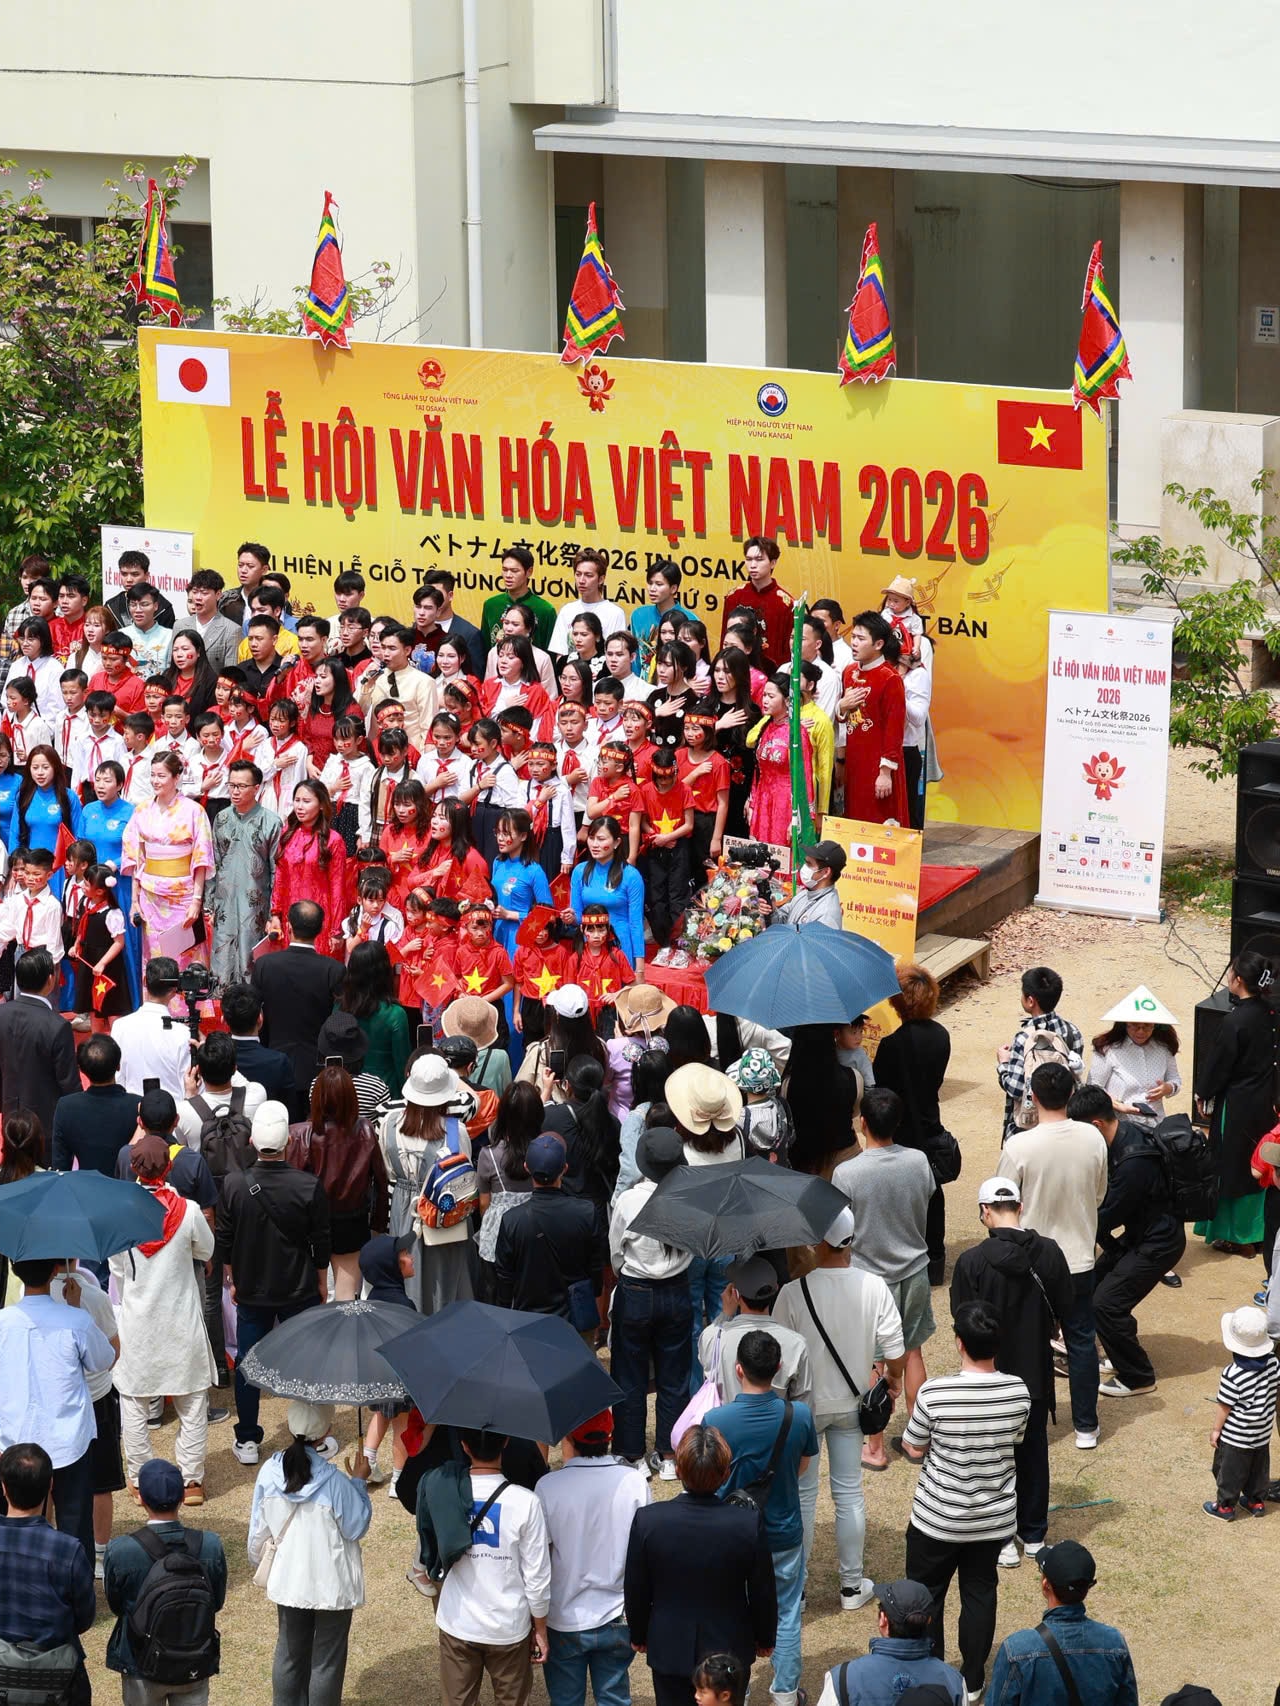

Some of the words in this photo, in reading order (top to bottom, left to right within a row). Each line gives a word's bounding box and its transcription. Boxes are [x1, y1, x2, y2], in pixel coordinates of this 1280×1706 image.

[425, 405, 447, 413] OSAKA
[463, 398, 478, 406] NAM
[726, 418, 742, 427] HIỆP
[742, 419, 756, 428] HỘI
[781, 421, 795, 430] VIỆT
[796, 423, 813, 431] NAM
[768, 431, 793, 440] KANSAI
[241, 390, 288, 498] LỄ
[302, 407, 377, 516] HỘI
[389, 415, 483, 520] VĂN
[499, 421, 595, 525] HÓA
[608, 430, 712, 544] VIỆT
[729, 454, 840, 546] NAM
[858, 465, 989, 562] 2026
[681, 555, 751, 582] OSAK
[157, 574, 172, 592] VIỆT
[283, 554, 332, 579] HIỆN
[369, 558, 406, 583] GIỖ
[603, 580, 646, 605] LẦN
[705, 594, 718, 612] 9
[937, 612, 988, 639] BẢN
[1052, 656, 1062, 677] LỄ
[1065, 660, 1079, 680] HỘI
[1082, 661, 1100, 681] VĂN
[1102, 663, 1120, 682] HÓA
[1123, 665, 1143, 685] VIỆT
[1145, 670, 1166, 686] NAM
[1097, 687, 1121, 705] 2026
[1064, 707, 1151, 723] ベトナム文化祭2026
[1135, 998, 1156, 1011] 10
